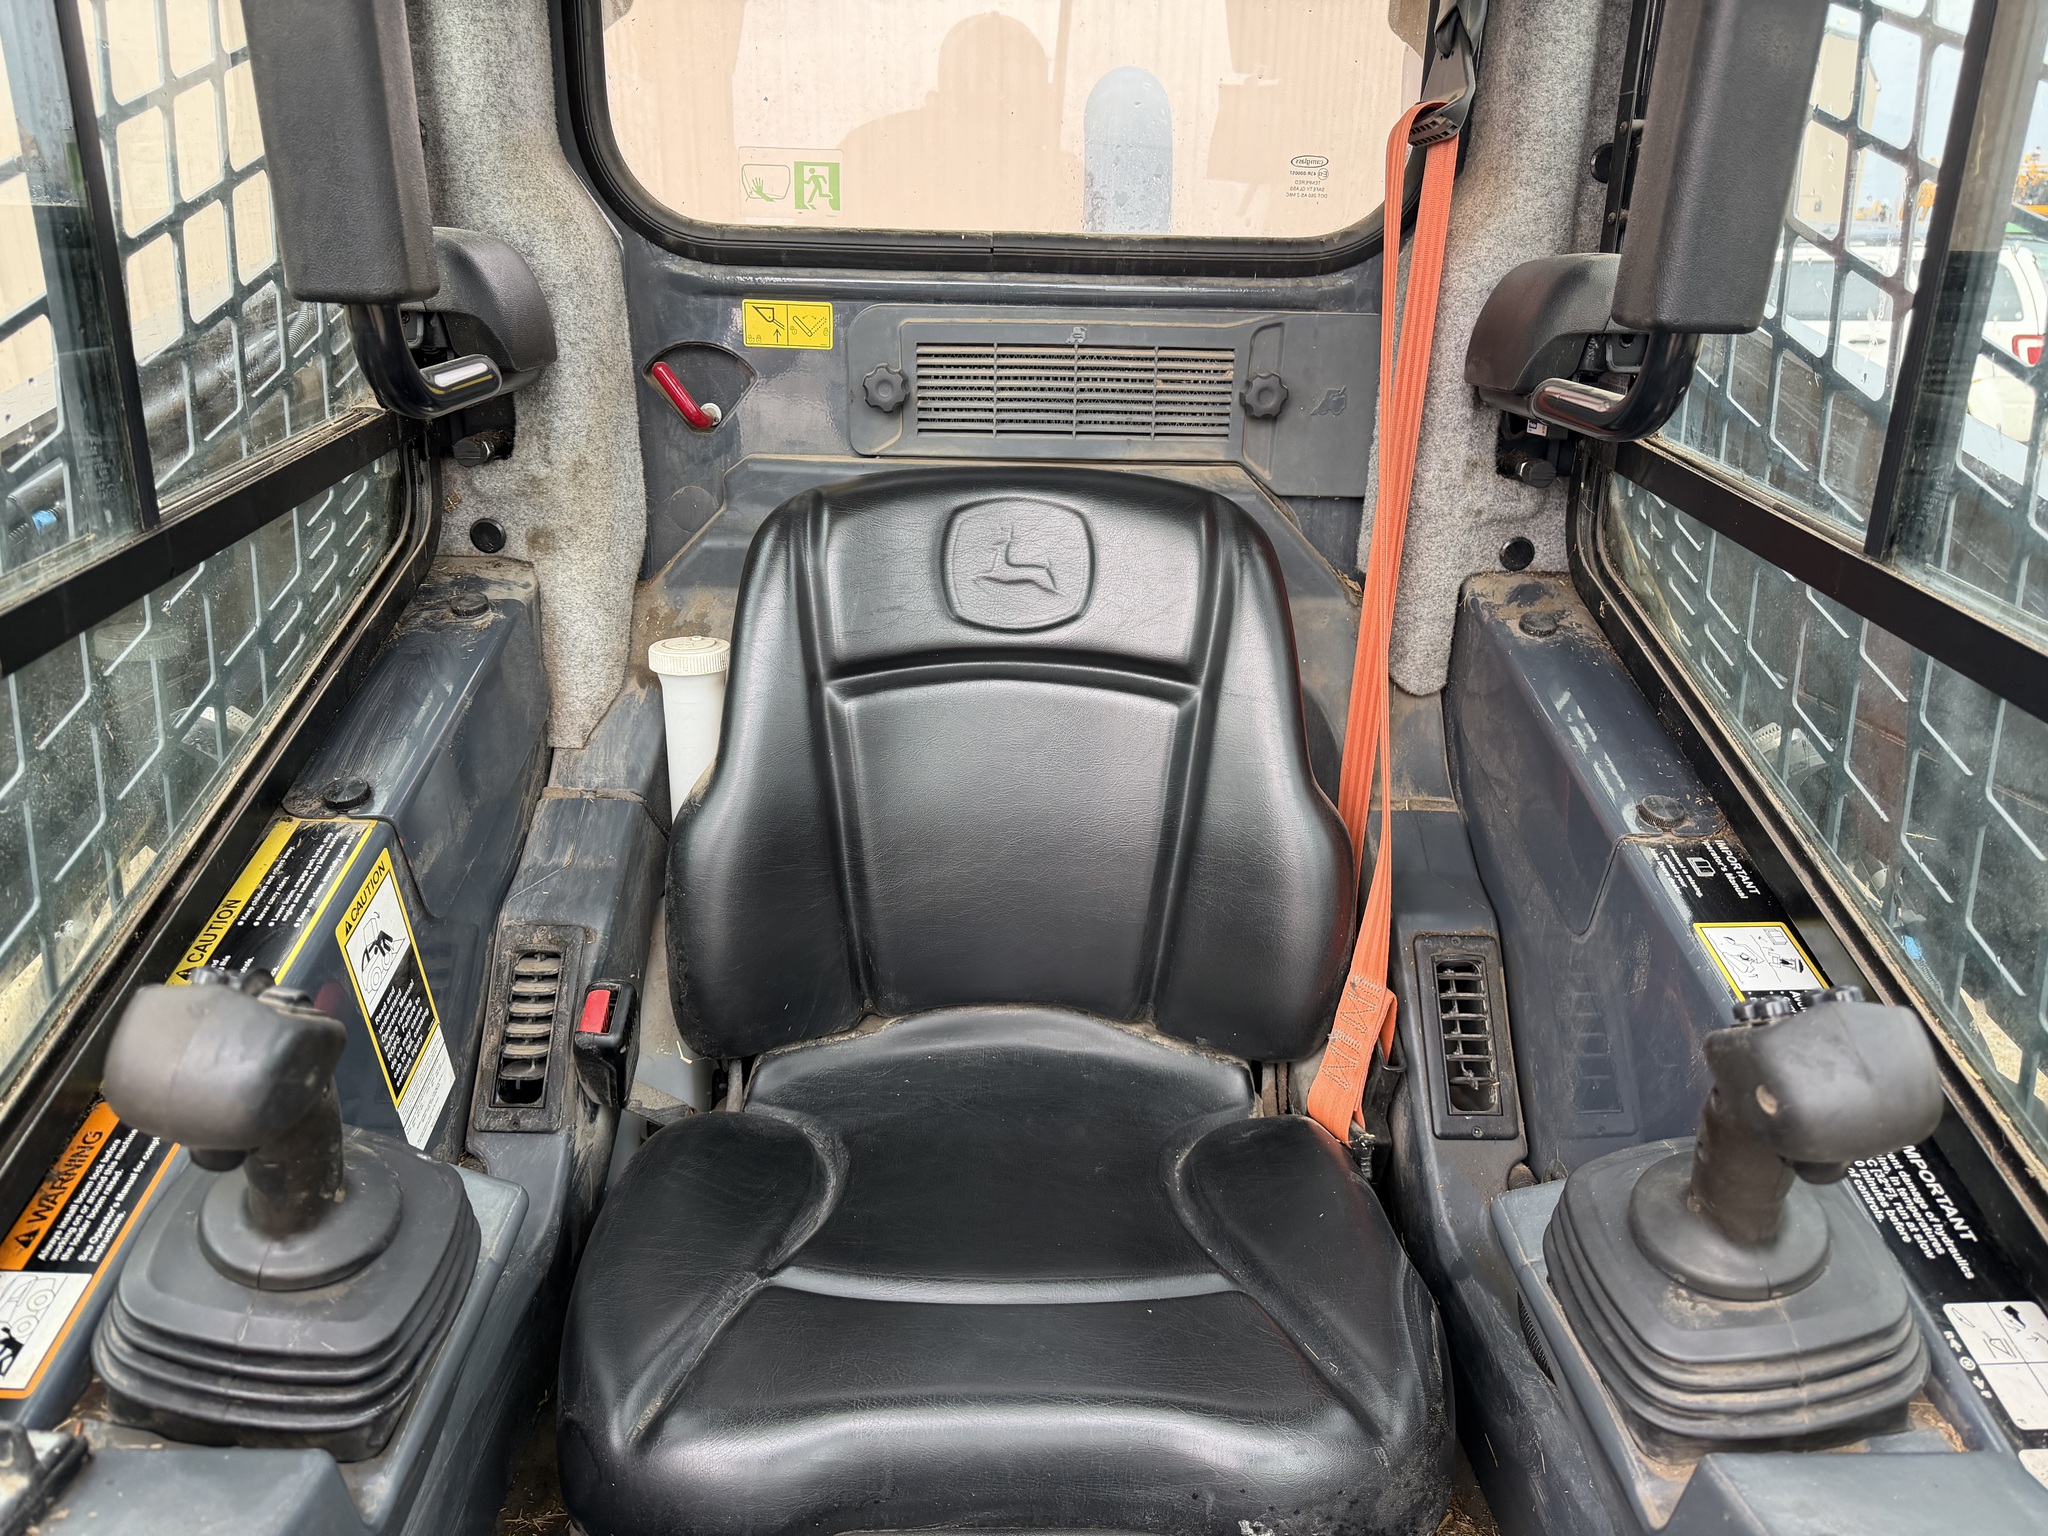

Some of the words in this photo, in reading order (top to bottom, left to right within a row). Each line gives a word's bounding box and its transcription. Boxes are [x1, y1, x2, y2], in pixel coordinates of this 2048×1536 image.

[350, 860, 386, 922] CAUTION
[1702, 841, 1728, 871] perator's
[1724, 872, 1748, 898] Manual
[1715, 840, 1760, 895] IMPORTANT
[187, 898, 242, 964] CAUTION
[375, 1002, 387, 1025] Read
[387, 986, 395, 1004] and
[379, 988, 402, 1034] understand
[381, 1008, 400, 1043] Operator
[399, 979, 414, 1008] Manual
[384, 1026, 398, 1052] before
[398, 999, 412, 1026] raising
[387, 1035, 401, 1061] ROPS.
[402, 1006, 415, 1032] Failure
[415, 997, 420, 1005] to
[391, 1058, 397, 1069] do
[397, 1047, 403, 1058] so
[402, 1029, 411, 1047] may
[411, 1006, 422, 1029] cause
[394, 1063, 402, 1078] cab
[401, 1053, 406, 1062] to
[414, 1008, 429, 1037] causing
[397, 1057, 411, 1087] serious
[28, 1131, 103, 1226] WARNING
[37, 1230, 62, 1261] Always
[57, 1204, 78, 1228] install
[74, 1181, 94, 1203] boom
[89, 1164, 102, 1179] lock
[101, 1139, 121, 1162] before
[50, 1228, 77, 1260] working
[72, 1215, 83, 1225] on
[81, 1205, 90, 1213] or
[86, 1176, 108, 1203] around
[104, 1161, 118, 1175] this
[115, 1129, 138, 1159] machine
[78, 1245, 93, 1261] See
[89, 1202, 119, 1243] Operator's
[115, 1173, 138, 1201] Manual
[133, 1161, 145, 1172] for
[143, 1137, 161, 1160] compl
[1854, 1179, 1885, 1222] controls.
[1859, 1169, 1889, 1208] minutes
[1885, 1210, 1911, 1243] before
[1903, 1146, 1978, 1243] MPORTANT
[61, 1247, 74, 1261] the
[70, 1221, 91, 1245] loader
[87, 1196, 106, 1218] boom
[104, 1169, 124, 1194] raised.
[89, 1211, 126, 1261] instructions.
[1889, 1176, 1901, 1186] in
[1897, 1188, 1945, 1255] temperatures
[1893, 1203, 1910, 1220] run
[1906, 1222, 1919, 1233] at
[1914, 1233, 1936, 1259] slow
[1899, 1171, 1928, 1209] damage
[1925, 1212, 1941, 1226] of
[1933, 1224, 1974, 1280] hydraulics
